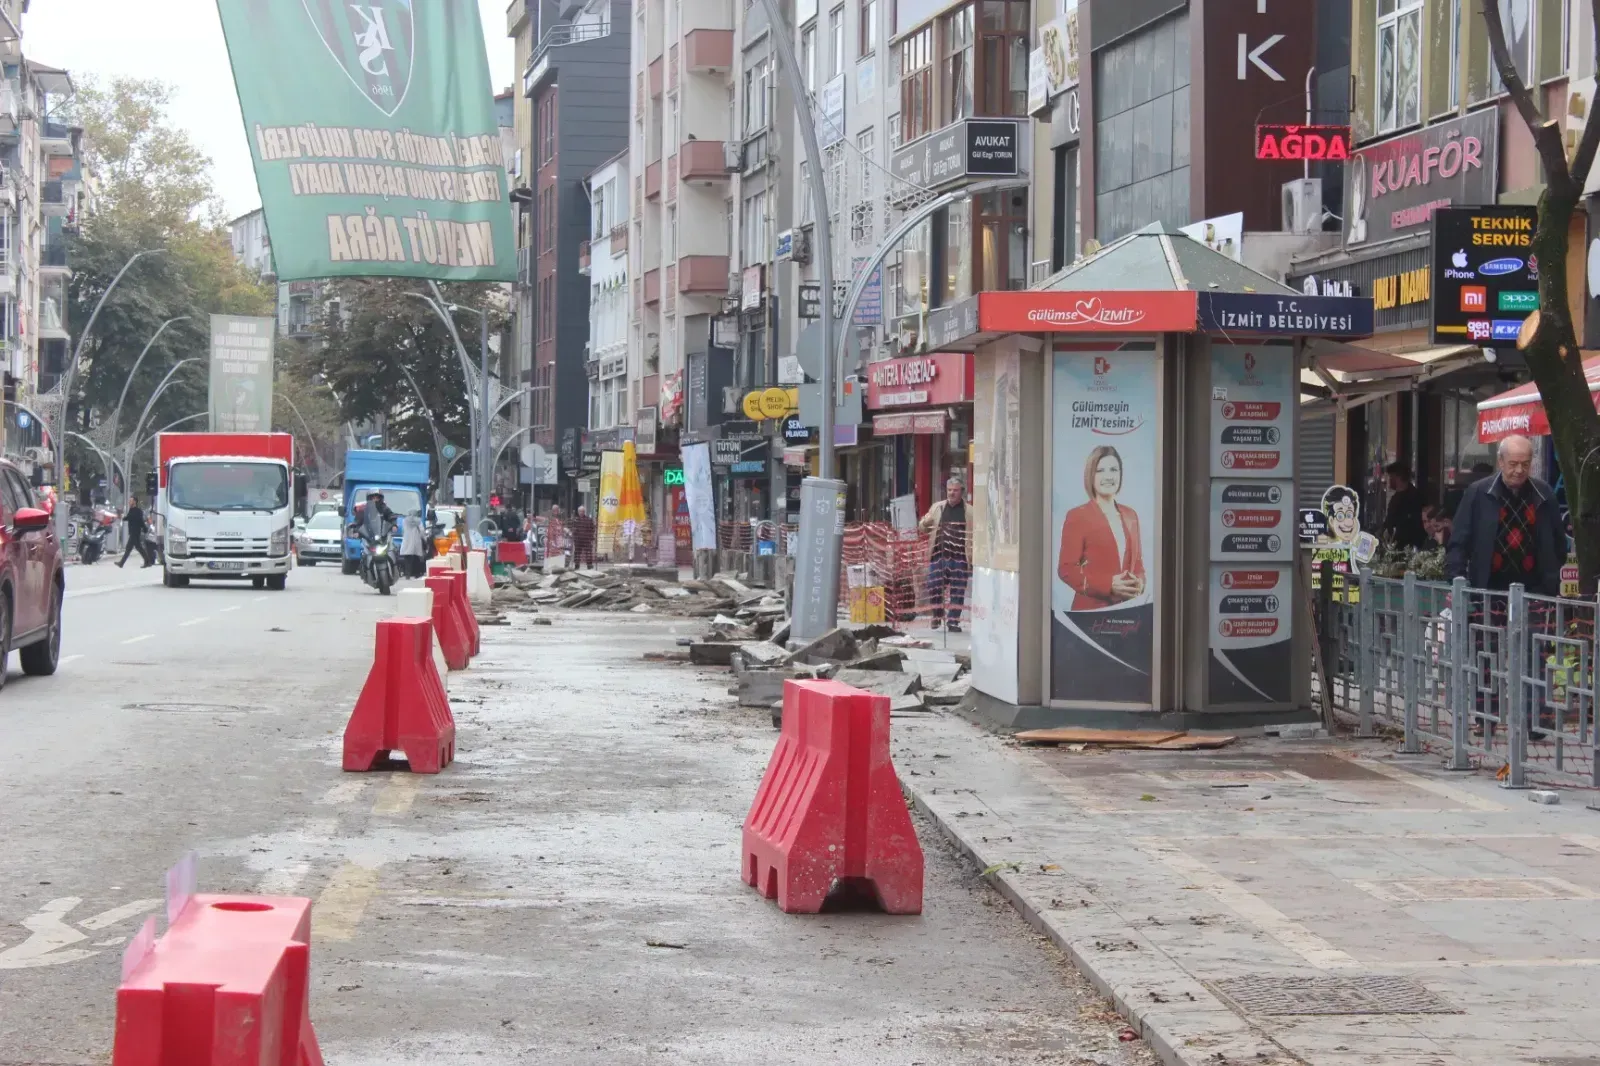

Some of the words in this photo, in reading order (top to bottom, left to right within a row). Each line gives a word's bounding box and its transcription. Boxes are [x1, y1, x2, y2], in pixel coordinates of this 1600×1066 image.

[975, 136, 1011, 147] AVUKAT
[1258, 127, 1348, 160] AĞDA
[972, 151, 982, 159] Gül
[994, 151, 1013, 159] TORUN
[1371, 130, 1482, 198] KUAFÖR
[1471, 215, 1532, 230] TEKNİK
[1472, 231, 1530, 246] SERVİS
[1484, 262, 1518, 271] SAMSUNG
[1444, 268, 1475, 279] iPhone
[1503, 294, 1536, 303] oppo
[1277, 301, 1302, 313] T.C.
[1027, 309, 1078, 321] Gülümse
[1100, 307, 1135, 321] İZMİT
[1221, 310, 1263, 327] İZMİT
[1269, 314, 1352, 331] BELEDİYESİ
[1467, 320, 1490, 333] gen
[1473, 329, 1490, 340] pa
[1072, 401, 1130, 415] Gülümseyin
[1072, 414, 1135, 429] İZMİT'tesiniz
[716, 441, 740, 452] TÜTÜN
[666, 471, 684, 484] DA
